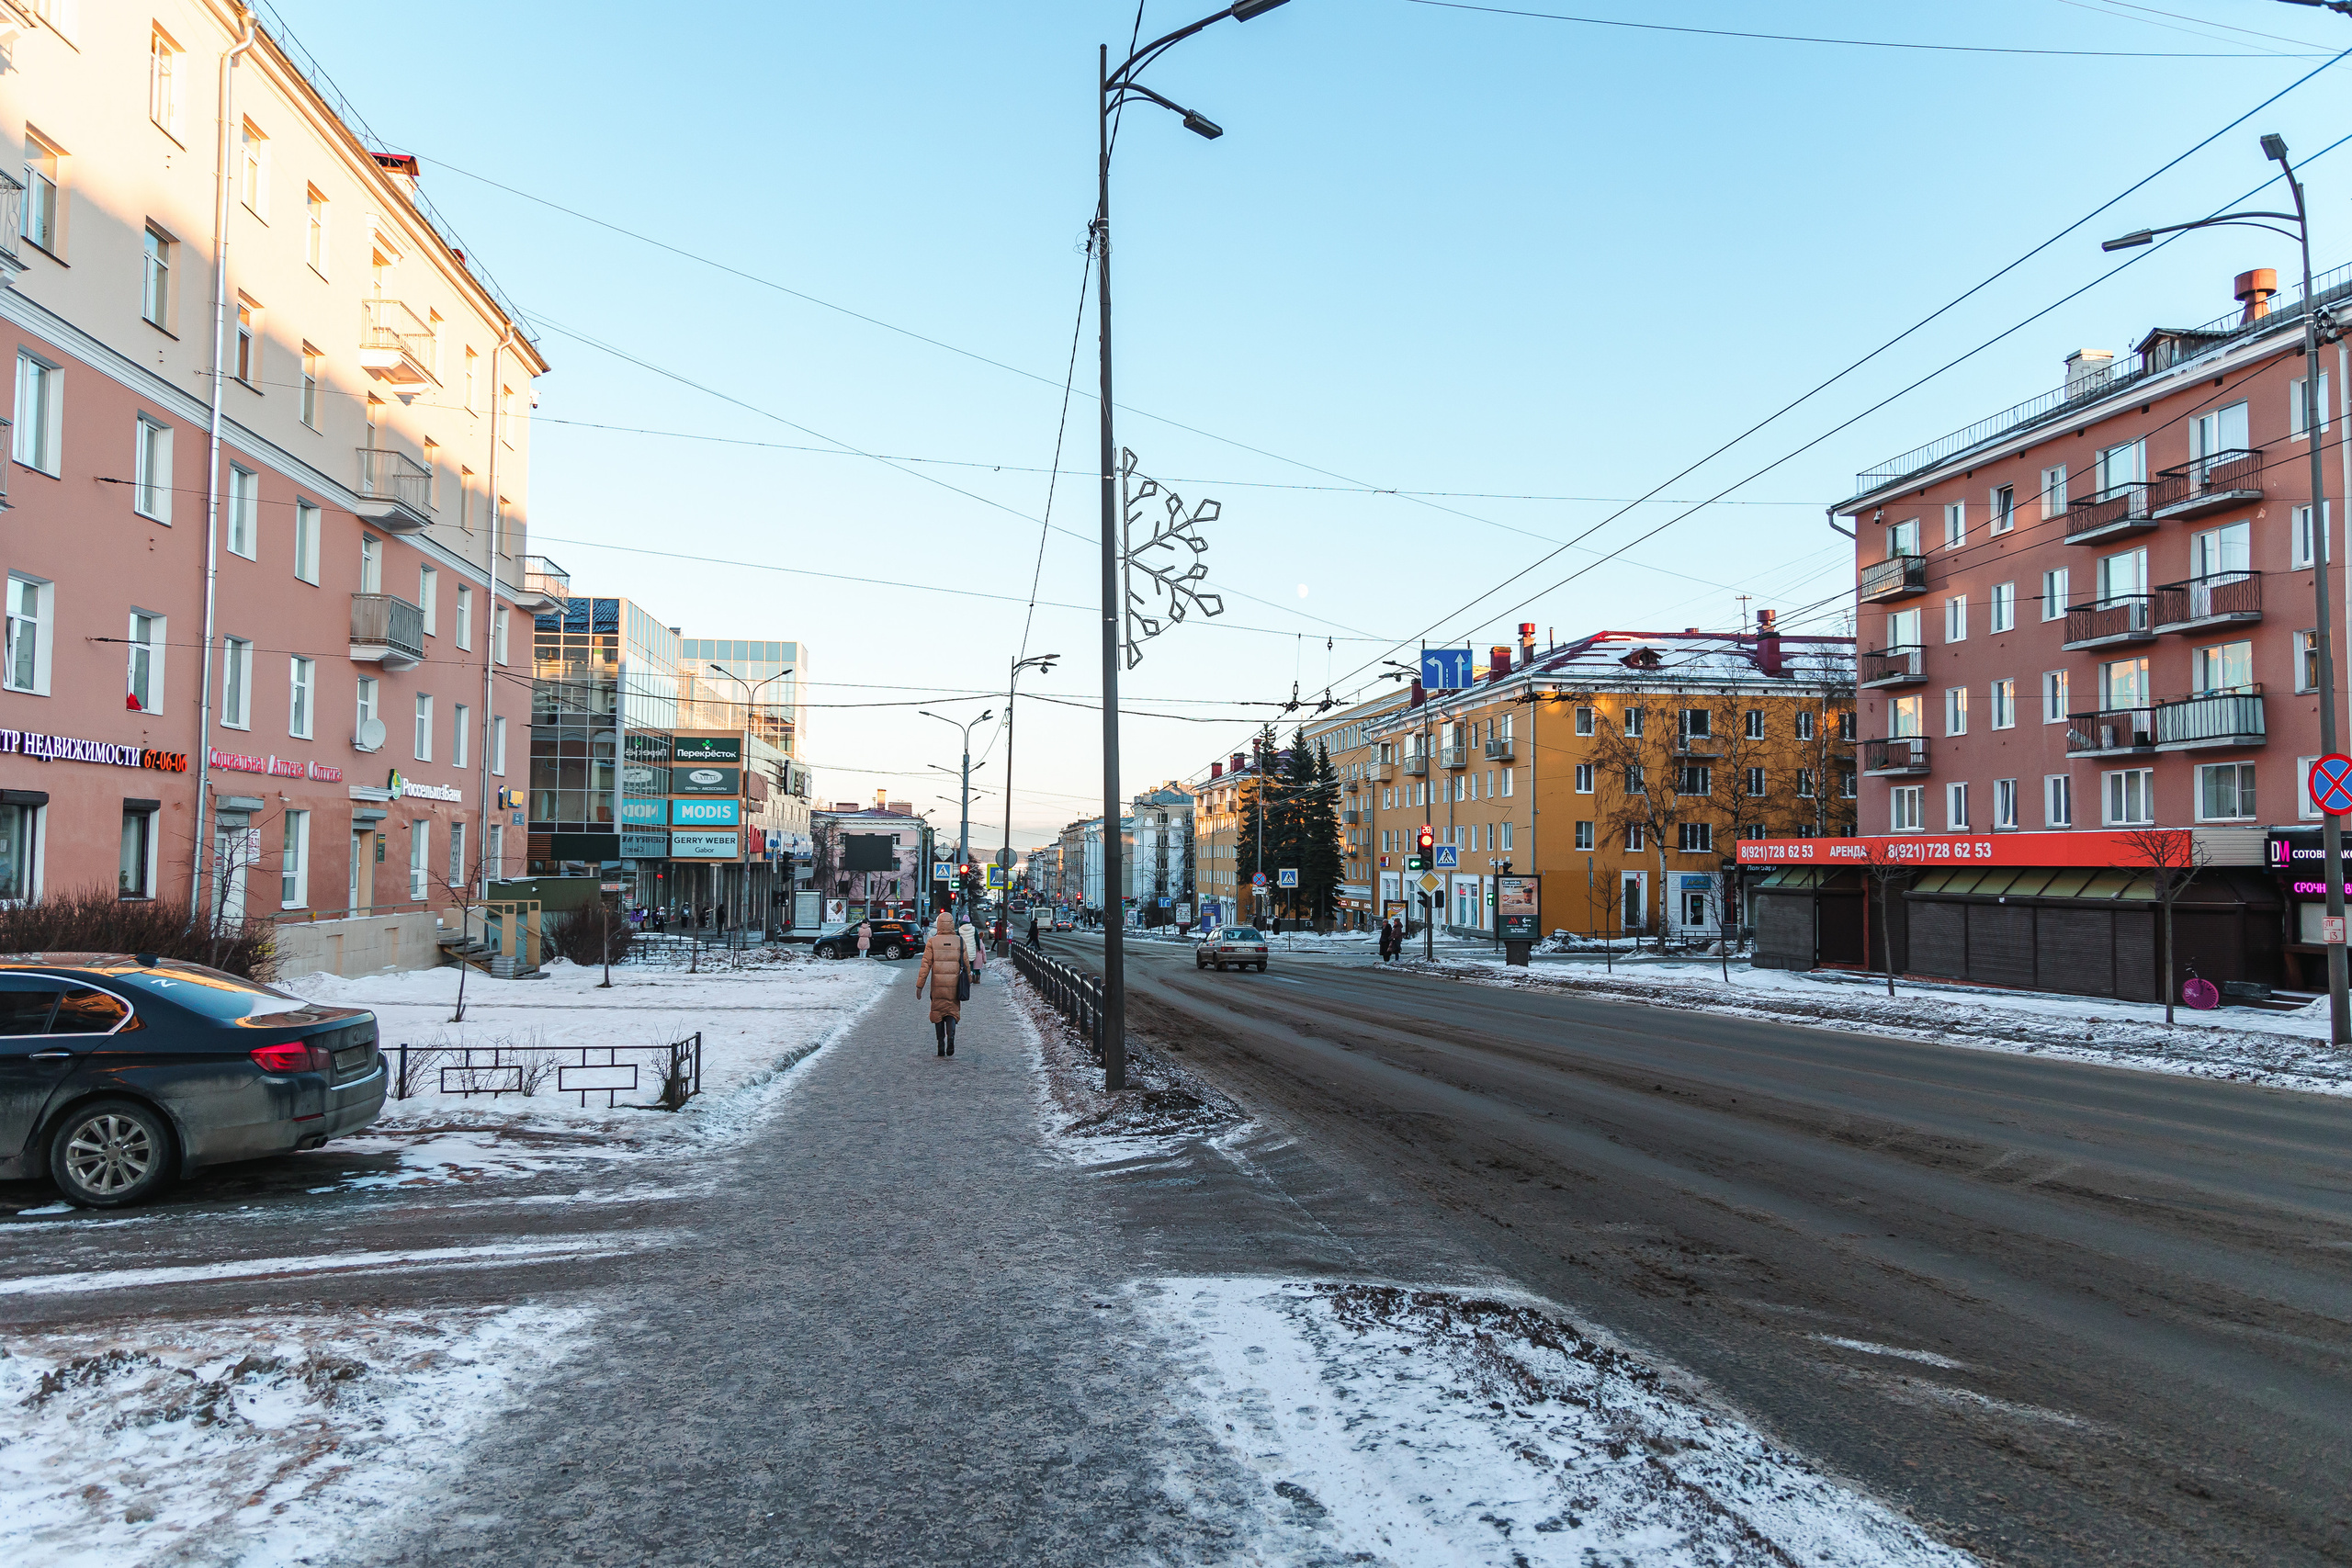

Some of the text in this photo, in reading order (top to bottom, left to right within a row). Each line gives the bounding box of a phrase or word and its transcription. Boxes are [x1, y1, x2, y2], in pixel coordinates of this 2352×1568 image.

[0, 728, 188, 773] ТР НЕДВИЖИМОСТИ 67-06-06
[677, 749, 736, 759] Перекрёсток
[209, 747, 344, 782] Социальная Аптека Оптика
[402, 777, 462, 802] РоссельхозБанк
[682, 806, 731, 818] MODIS
[1741, 842, 1992, 862] 8(921) 728 62 53 АРЕНДА 8(921) 728 62 53
[2292, 850, 2325, 859] СОТОВ
